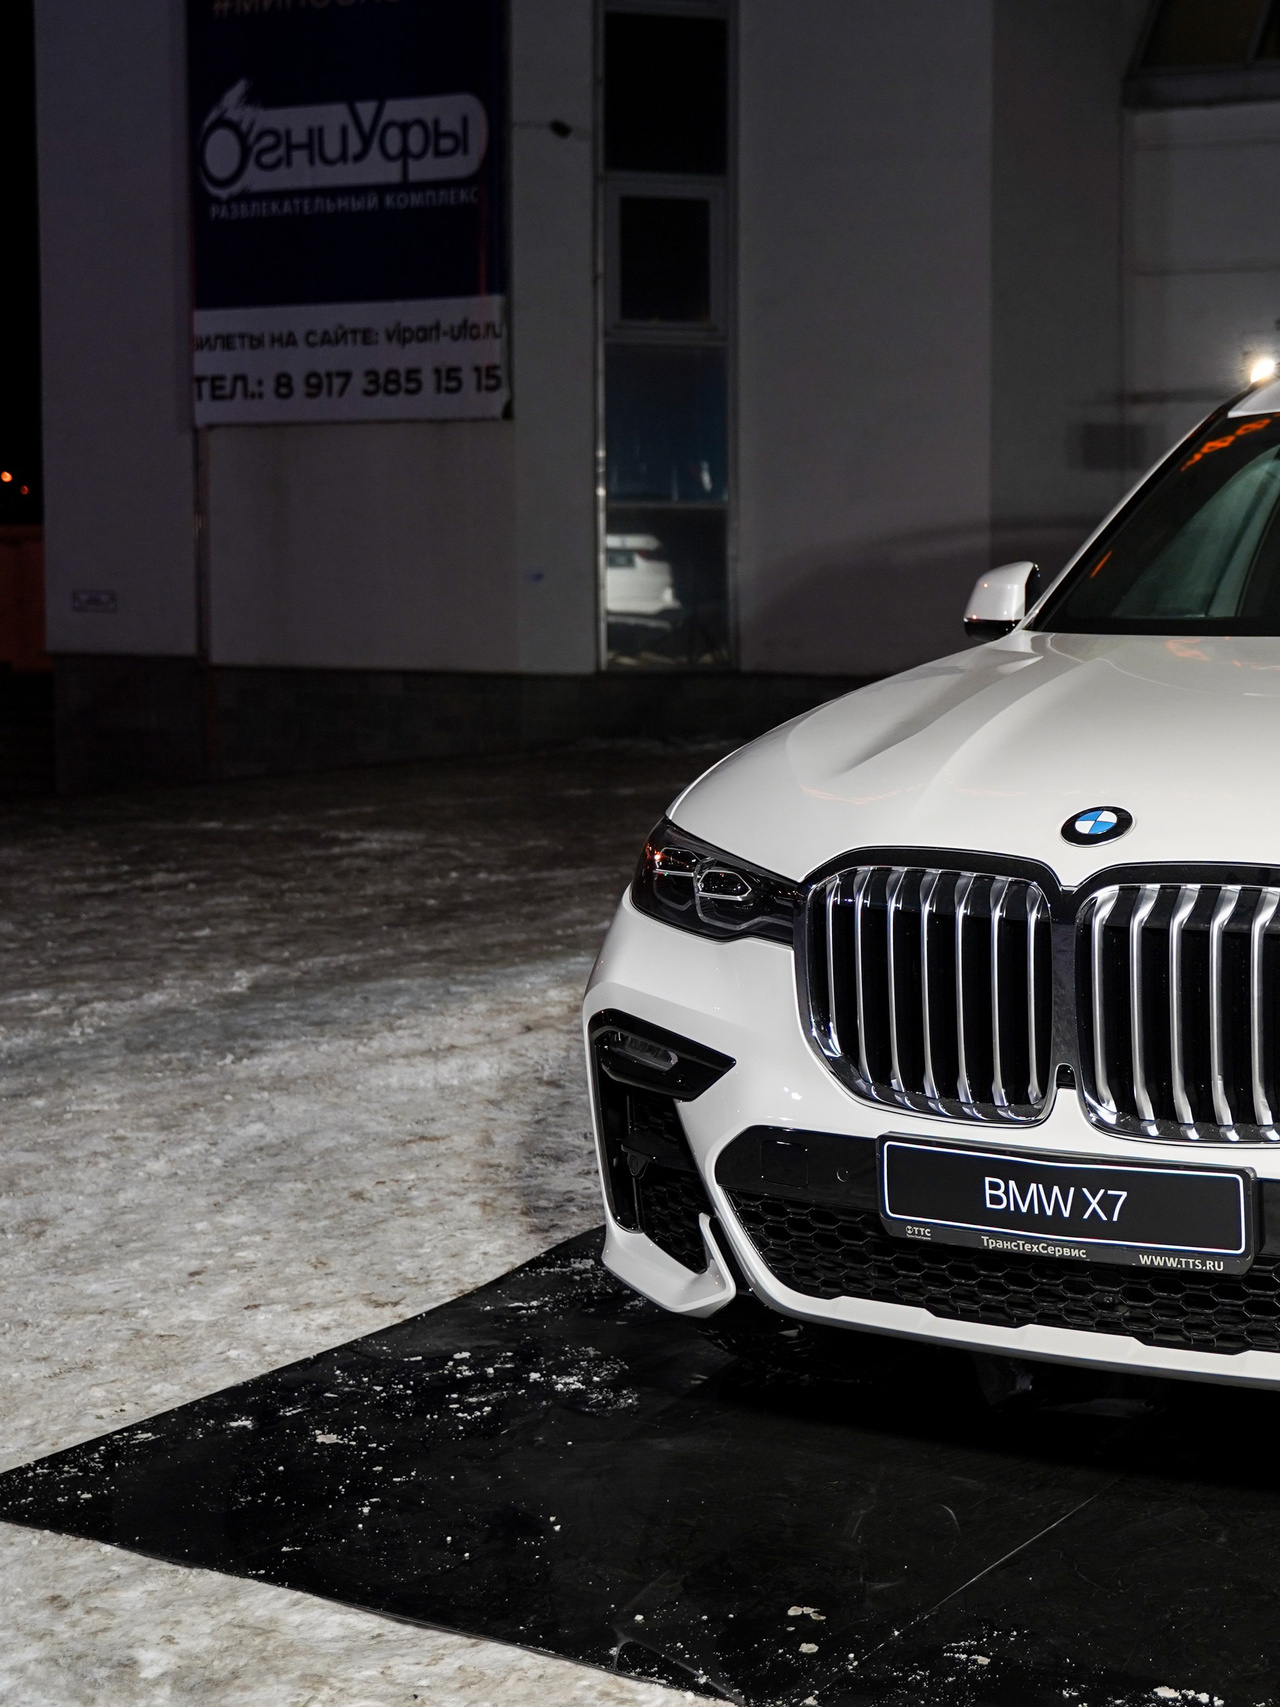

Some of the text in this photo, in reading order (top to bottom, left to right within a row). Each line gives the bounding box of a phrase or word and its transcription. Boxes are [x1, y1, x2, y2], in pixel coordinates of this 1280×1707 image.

[209, 186, 479, 222] РАЗВЛЕКАТЕЛЬНЫЙ КОМПЛЕКС
[270, 330, 298, 348] НА
[304, 323, 379, 347] САЙТЕ:
[194, 364, 501, 400] ТЕЛ.: 8 917 385 15 15
[984, 1176, 1128, 1222] BMW X7
[913, 1226, 932, 1237] ТТС
[981, 1235, 1087, 1258] ТрансТехСервис
[1139, 1254, 1224, 1271] WWW.TTS.RU
